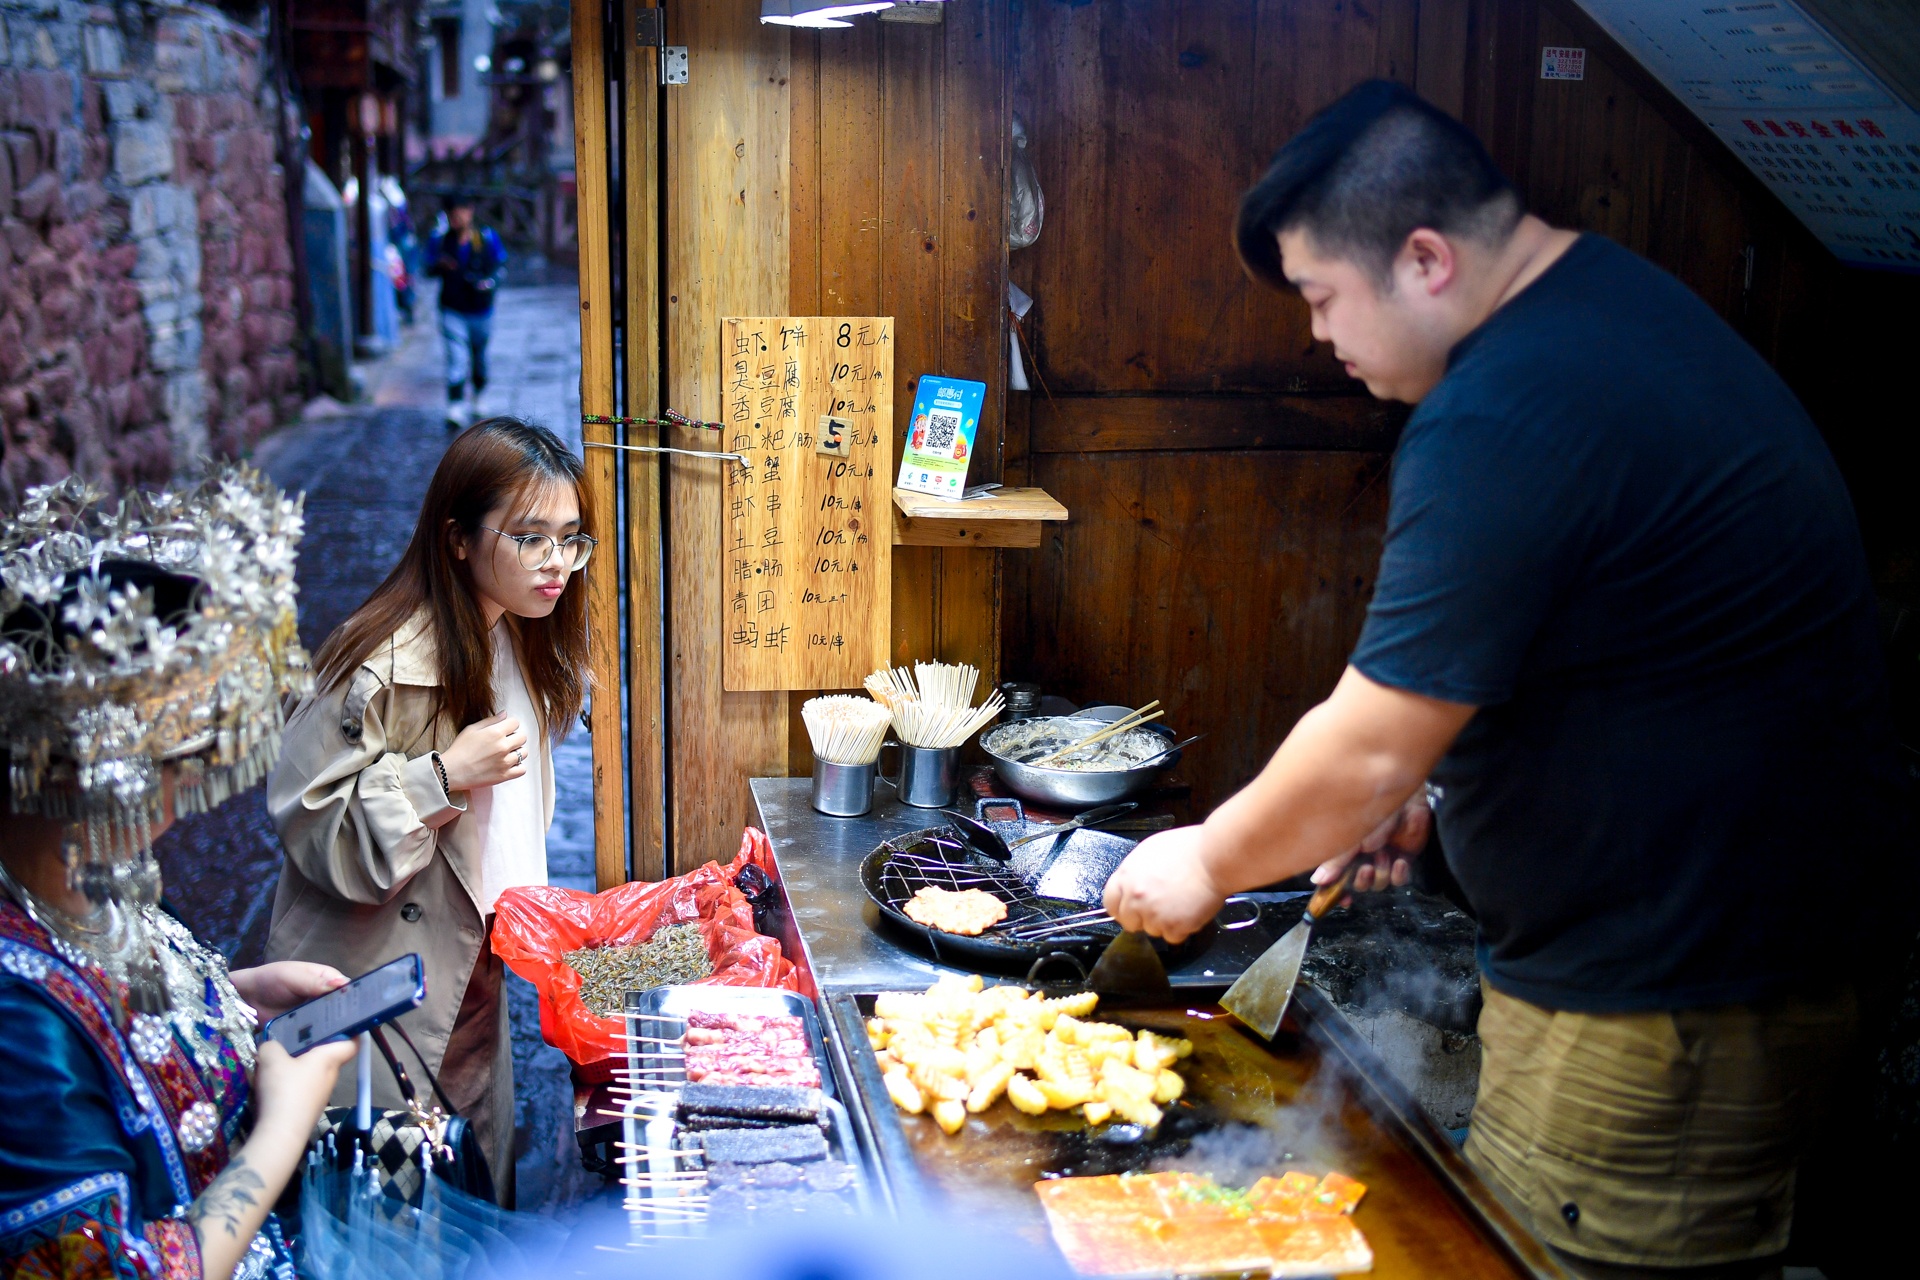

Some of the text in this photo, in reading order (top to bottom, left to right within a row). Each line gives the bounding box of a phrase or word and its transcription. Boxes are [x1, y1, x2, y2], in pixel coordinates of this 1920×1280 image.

[1741, 118, 1887, 138] 质量安全承诺
[836, 322, 890, 348] 8元/个
